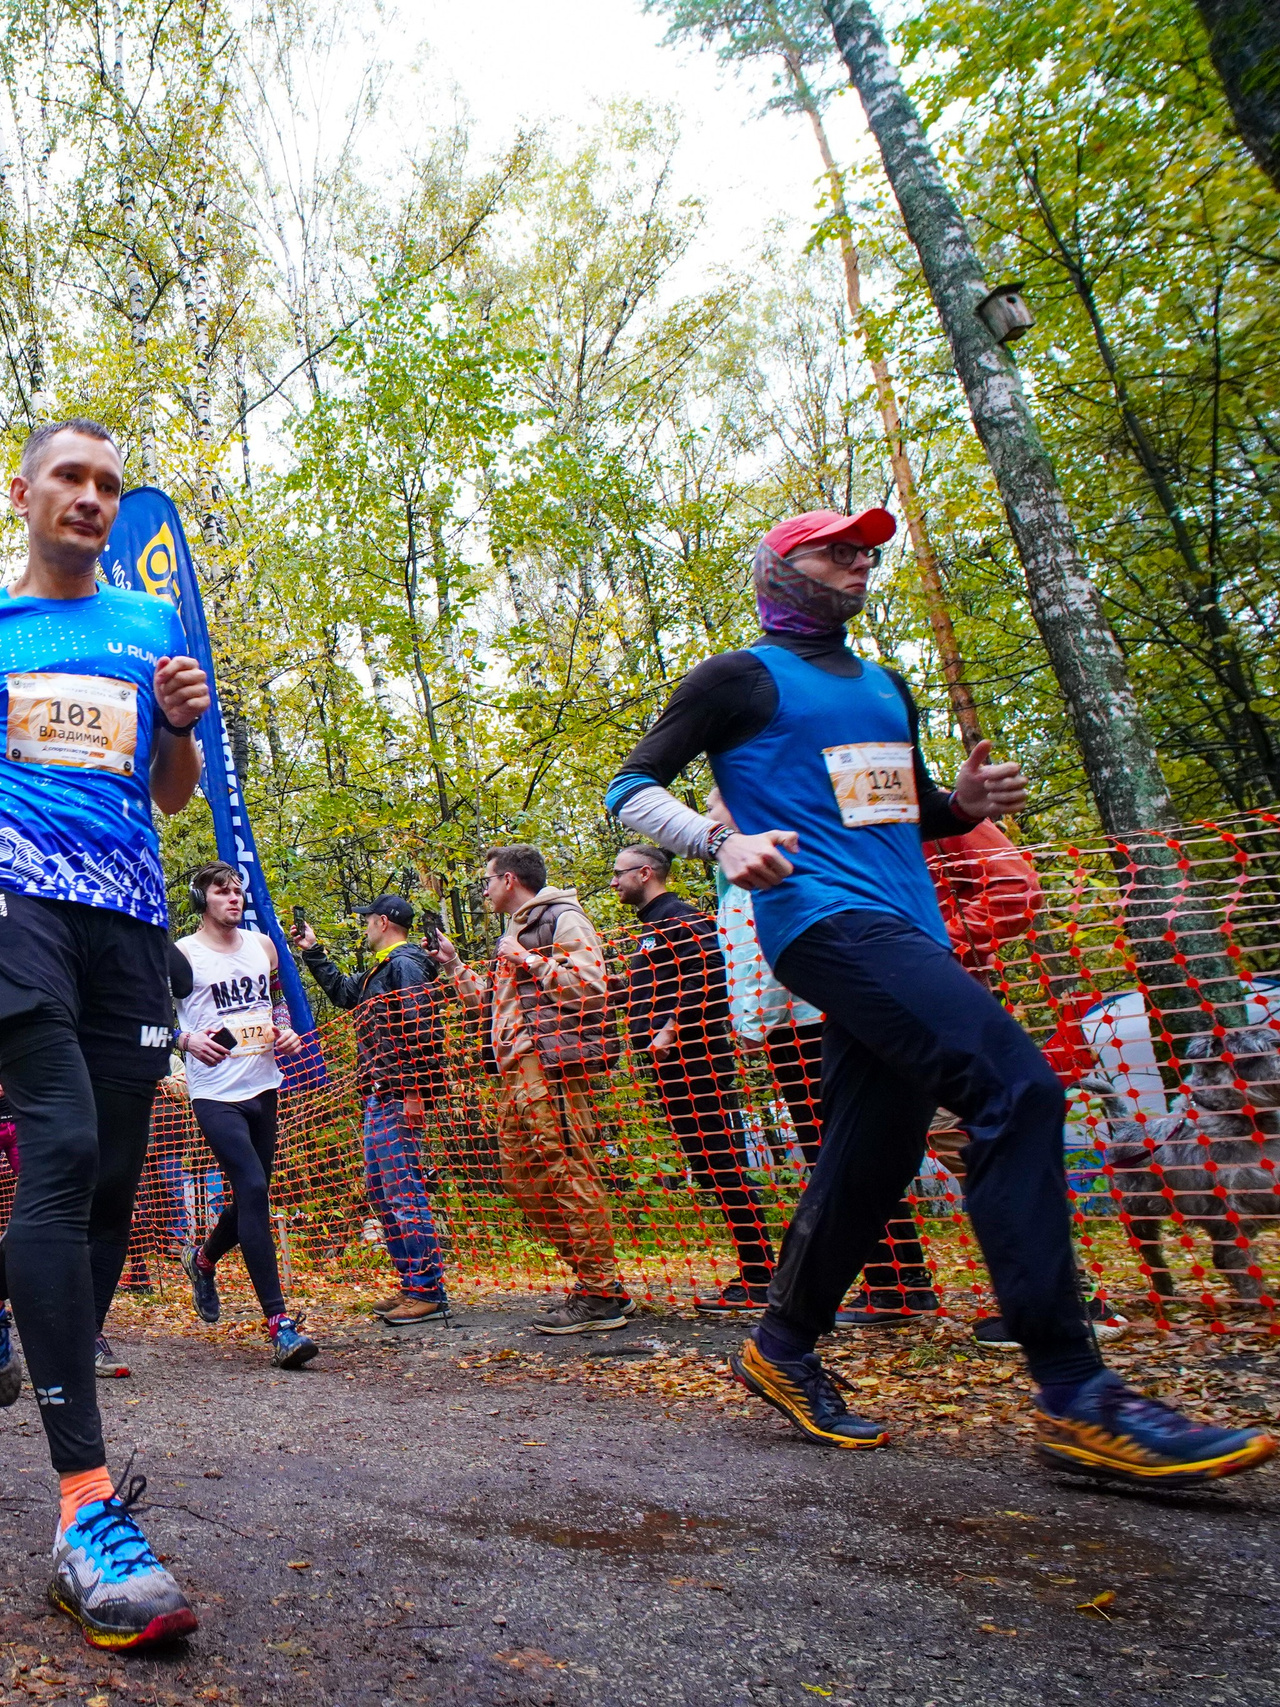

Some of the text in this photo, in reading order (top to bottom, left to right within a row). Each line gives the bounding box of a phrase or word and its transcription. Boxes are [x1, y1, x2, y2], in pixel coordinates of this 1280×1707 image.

[49, 700, 102, 730] 102
[39, 726, 109, 747] Владимир
[867, 769, 902, 790] 124
[241, 1026, 264, 1039] 172
